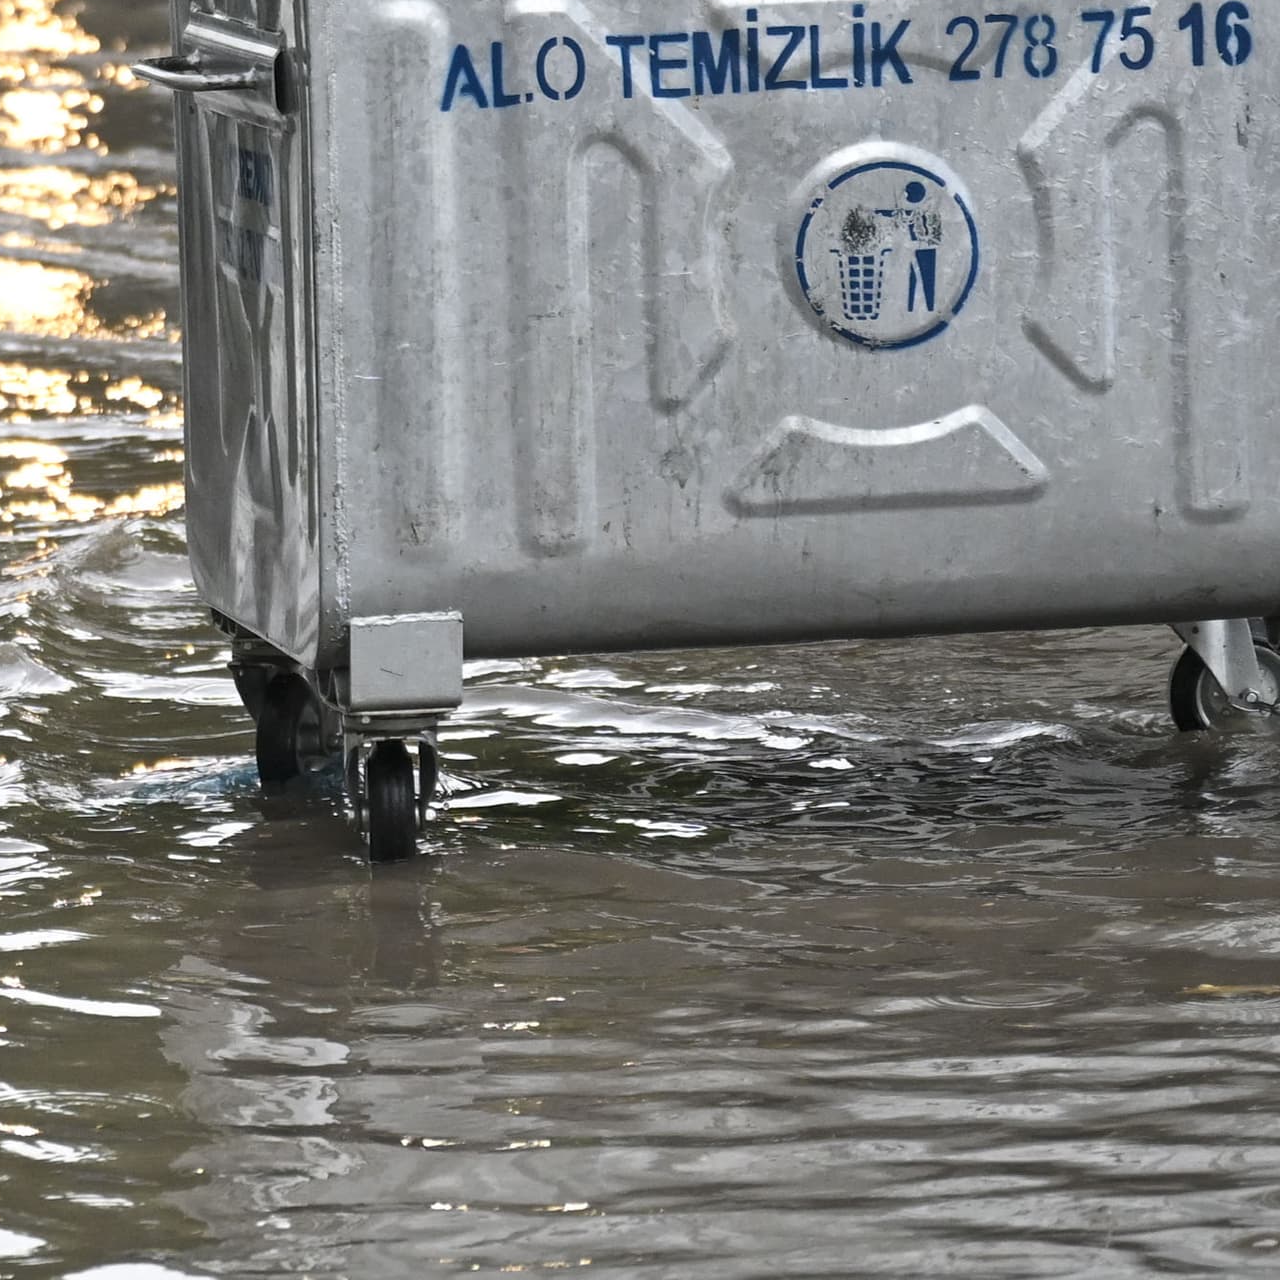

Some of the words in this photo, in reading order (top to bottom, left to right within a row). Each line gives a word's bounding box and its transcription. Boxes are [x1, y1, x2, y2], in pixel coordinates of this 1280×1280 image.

[604, 3, 914, 99] TEMİZLİK
[945, 13, 1058, 81] 278
[1081, 6, 1155, 74] 75
[1178, 0, 1253, 67] 16
